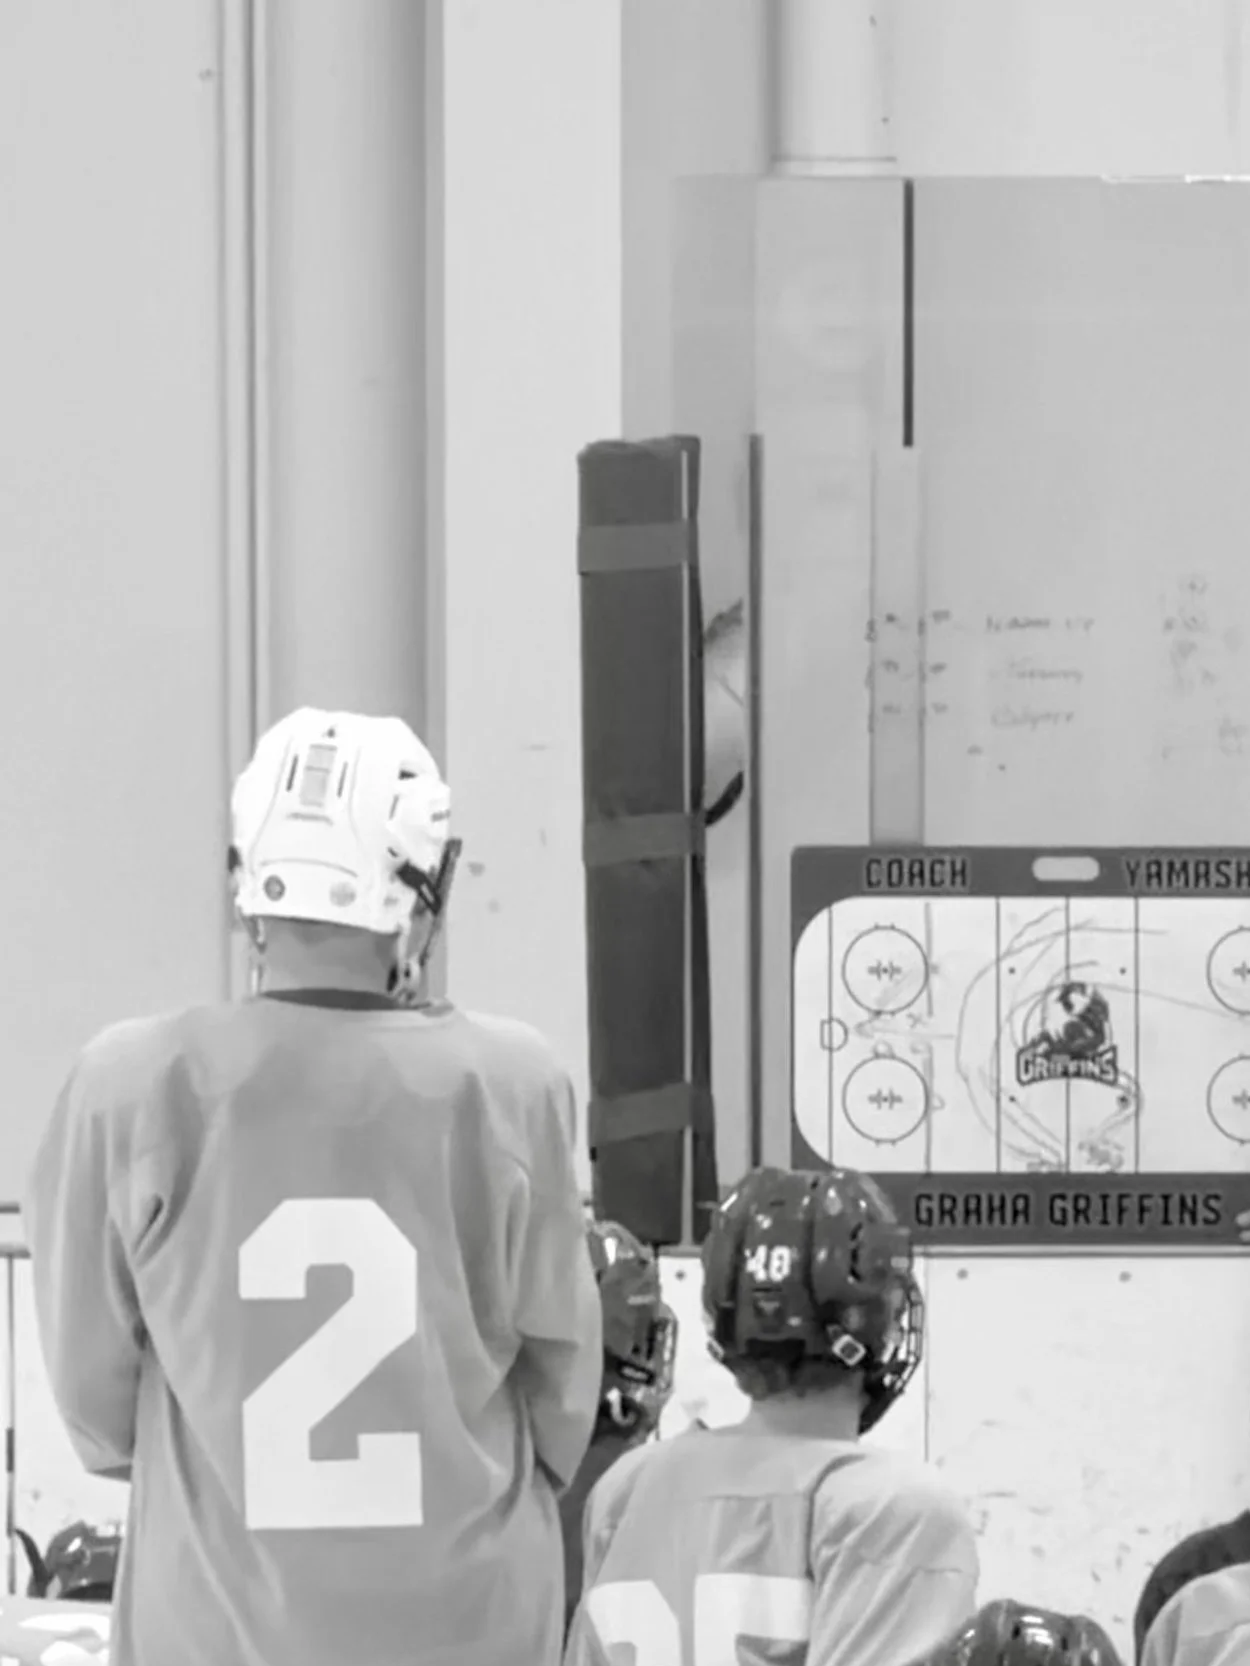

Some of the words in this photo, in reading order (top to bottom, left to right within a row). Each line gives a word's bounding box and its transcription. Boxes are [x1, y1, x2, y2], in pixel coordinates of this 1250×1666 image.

[865, 857, 967, 889] COACH
[914, 1192, 1031, 1227] GRAHA
[1049, 1192, 1223, 1227] GRIFFINS
[238, 1198, 423, 1530] 2
